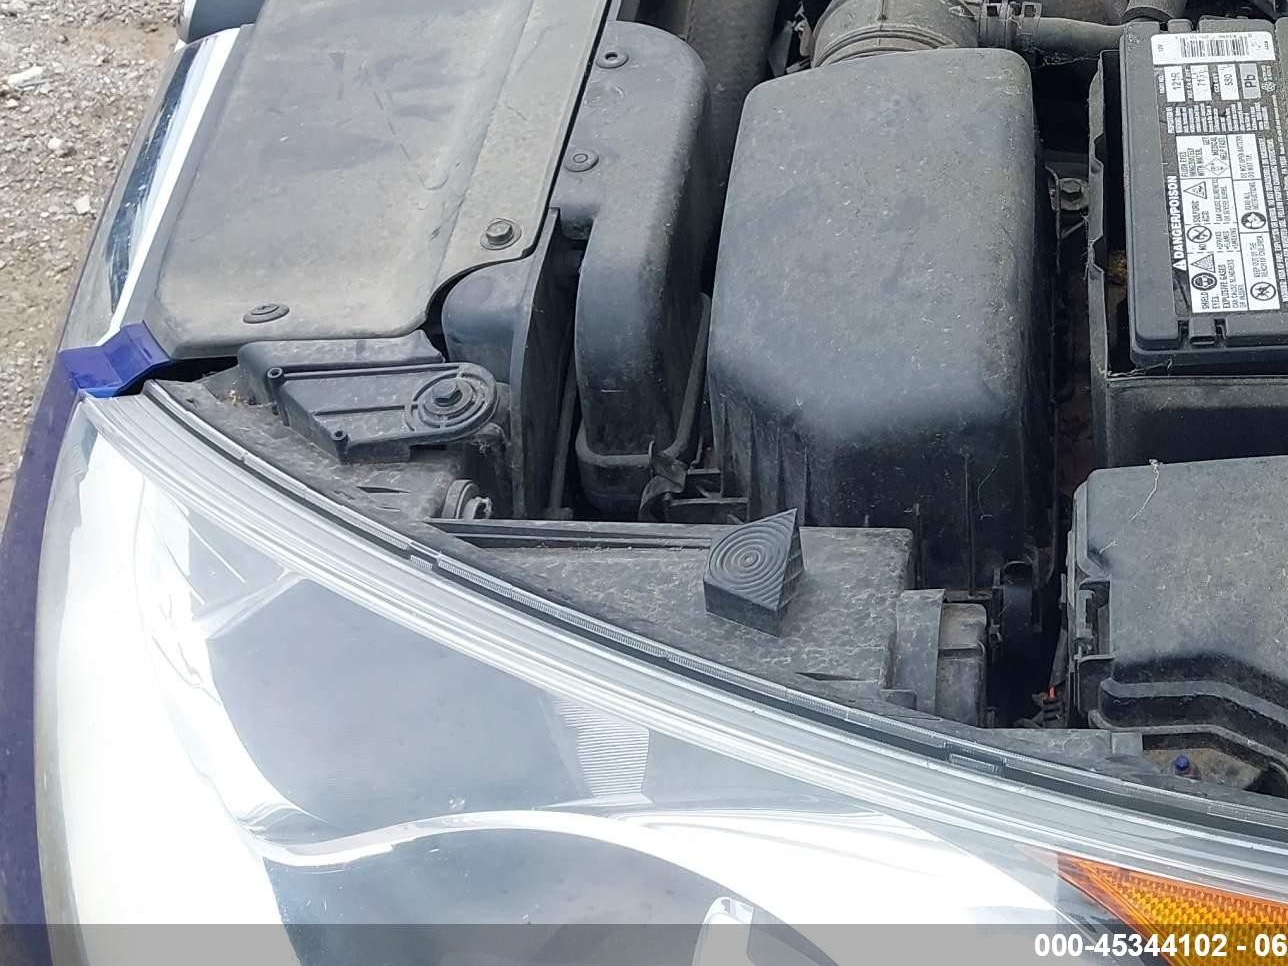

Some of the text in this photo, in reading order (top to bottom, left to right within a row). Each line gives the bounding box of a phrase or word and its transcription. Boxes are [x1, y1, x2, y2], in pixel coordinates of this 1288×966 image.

[1244, 74, 1257, 88] Pb
[1167, 176, 1185, 259] DANGER/POISON
[1192, 200, 1201, 223] SULFURIC
[1218, 264, 1231, 309] EXPLOSIVE GASES
[1200, 291, 1210, 309] SHIELD
